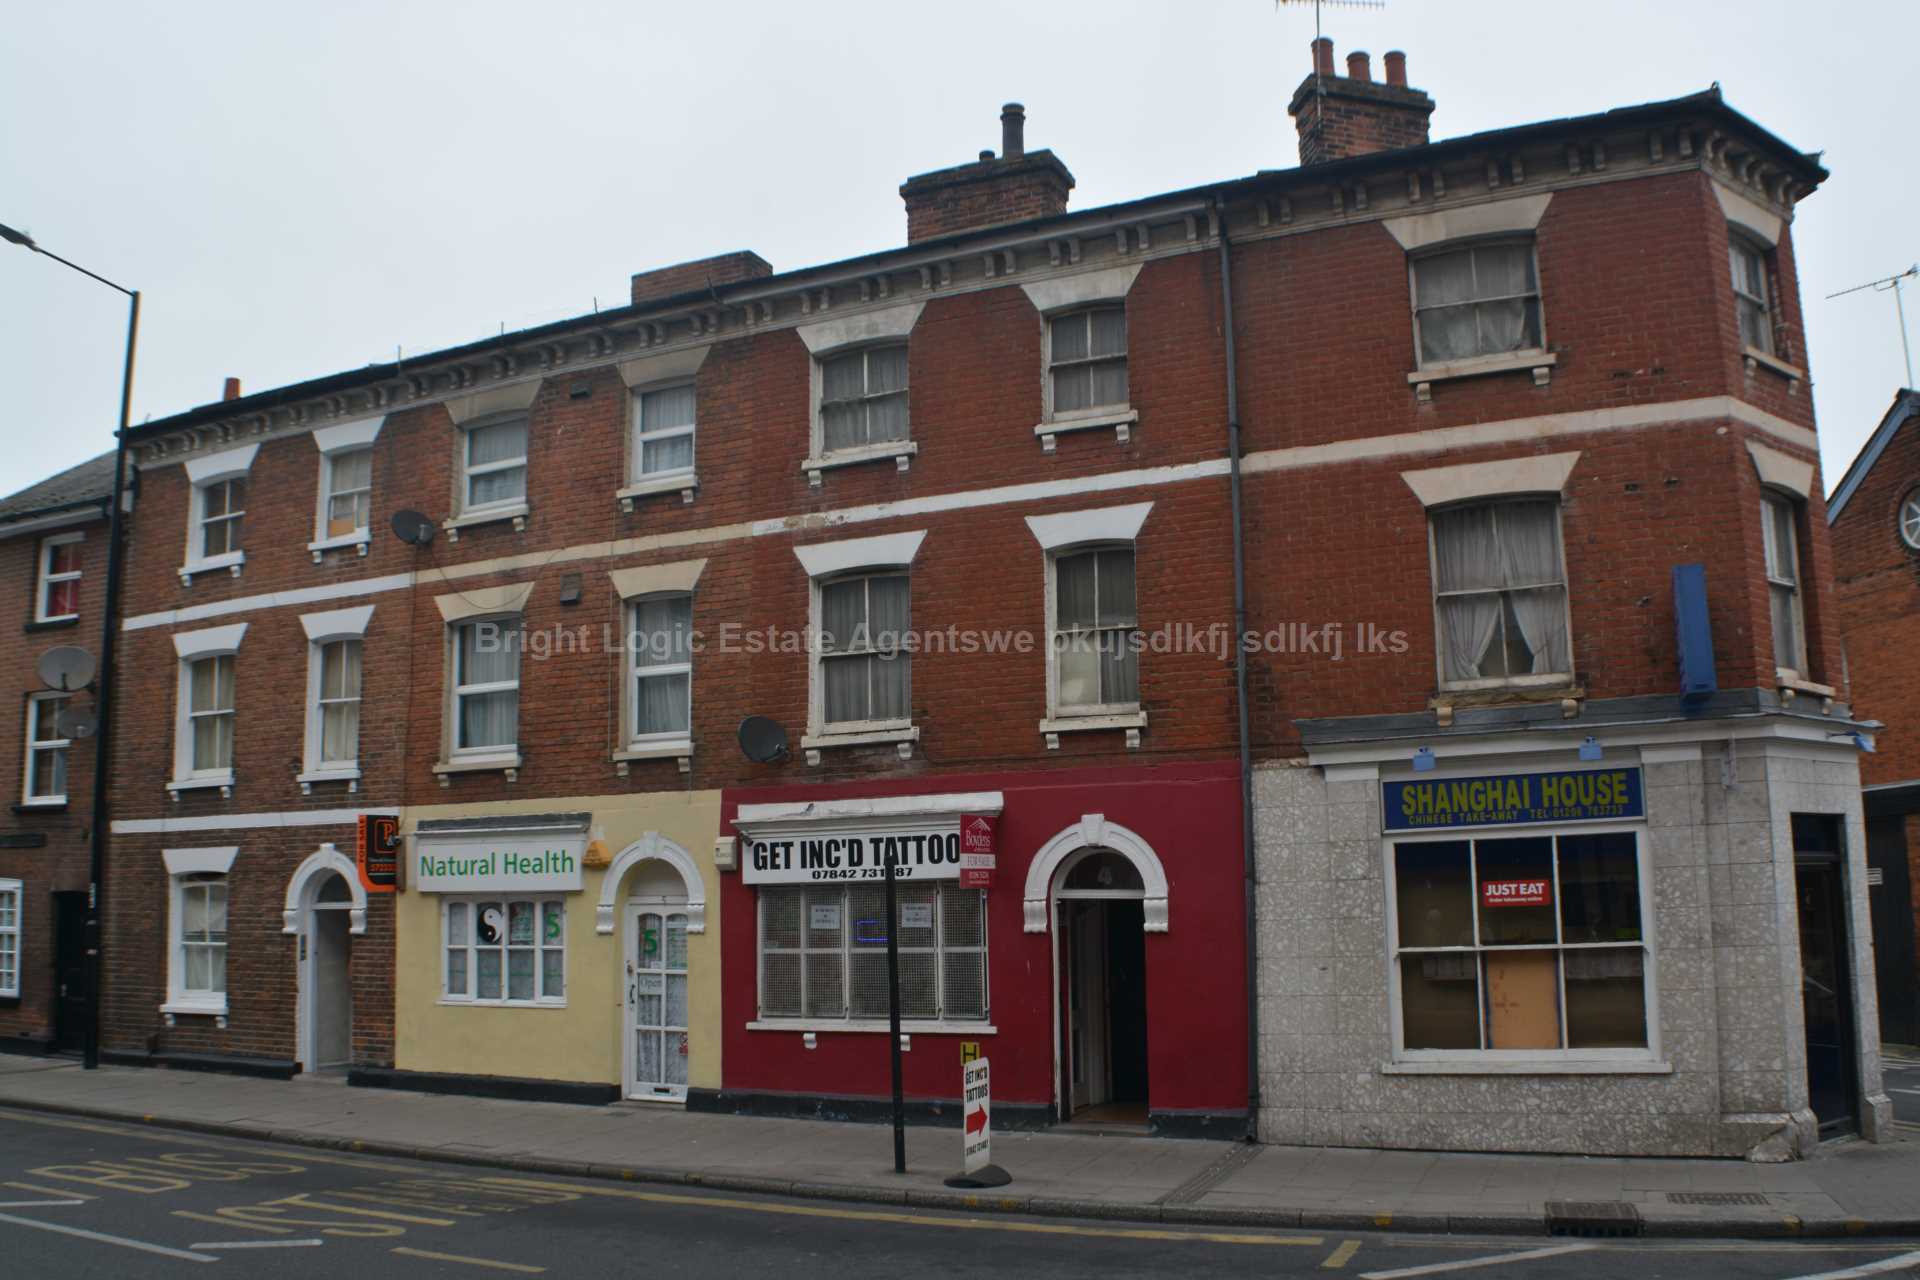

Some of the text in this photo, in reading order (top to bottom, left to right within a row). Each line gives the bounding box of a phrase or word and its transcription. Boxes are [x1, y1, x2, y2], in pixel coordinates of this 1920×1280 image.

[1402, 771, 1629, 816] SHANGHAI HOUSE
[1409, 812, 1453, 825] CHINESE
[420, 850, 575, 876] Natural Health
[753, 841, 794, 871] GET
[800, 838, 864, 869] INC'D
[812, 867, 913, 880] 07842 73187
[1486, 882, 1545, 895] JUST EAT
[546, 911, 561, 939] 5
[643, 928, 657, 955] 5
[963, 1043, 977, 1065] H
[966, 1070, 974, 1084] GET
[966, 1083, 988, 1103] TATTOOS
[25, 1153, 307, 1194] BUS
